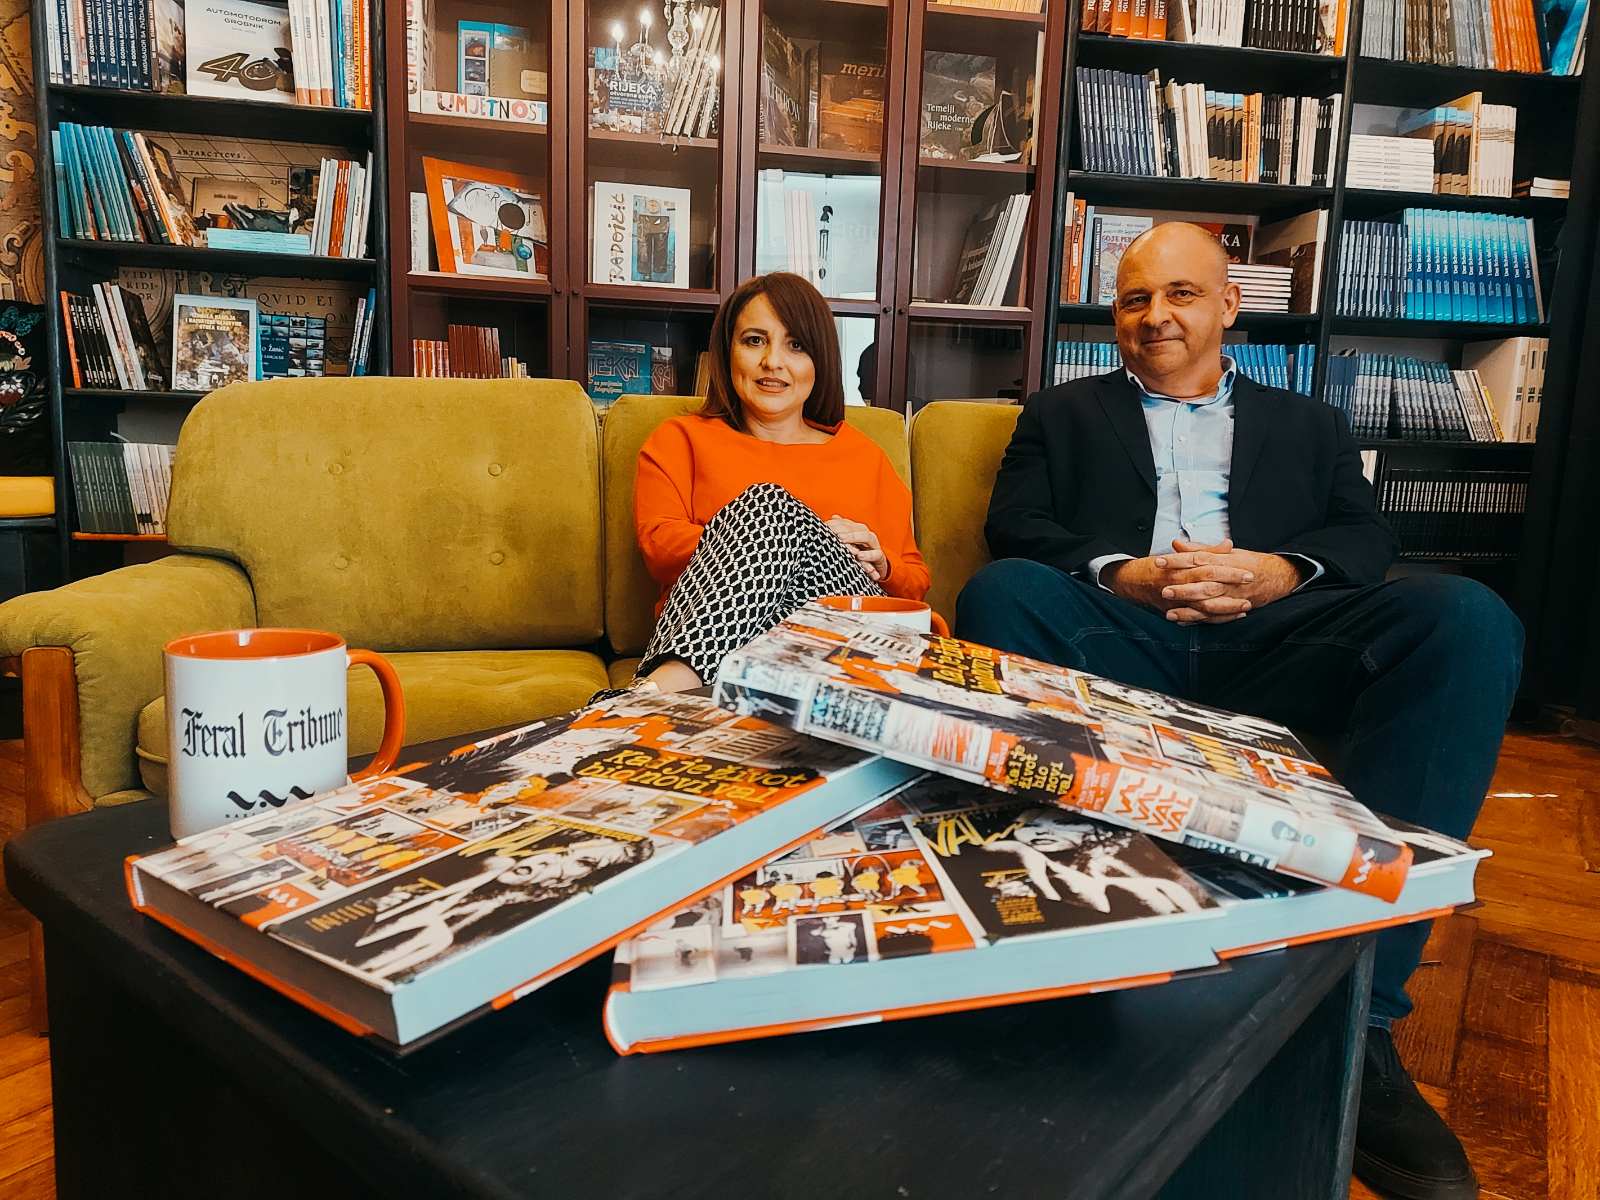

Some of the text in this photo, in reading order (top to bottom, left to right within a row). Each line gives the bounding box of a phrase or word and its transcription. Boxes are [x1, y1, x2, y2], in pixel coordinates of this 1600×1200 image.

[206, 8, 281, 25] AUTOMOTODROM
[224, 18, 264, 30] GROBNIK
[609, 81, 657, 95] RIJEKA
[926, 103, 955, 114] Temelji
[927, 121, 952, 130] Rijeke
[258, 293, 306, 307] QVID
[181, 704, 343, 758] Feral Tribune
[576, 762, 779, 803] bio novi val
[663, 759, 712, 774] je
[705, 765, 806, 787] život
[1032, 766, 1049, 788] bio
[1046, 761, 1063, 793] novi
[1057, 773, 1074, 795] val
